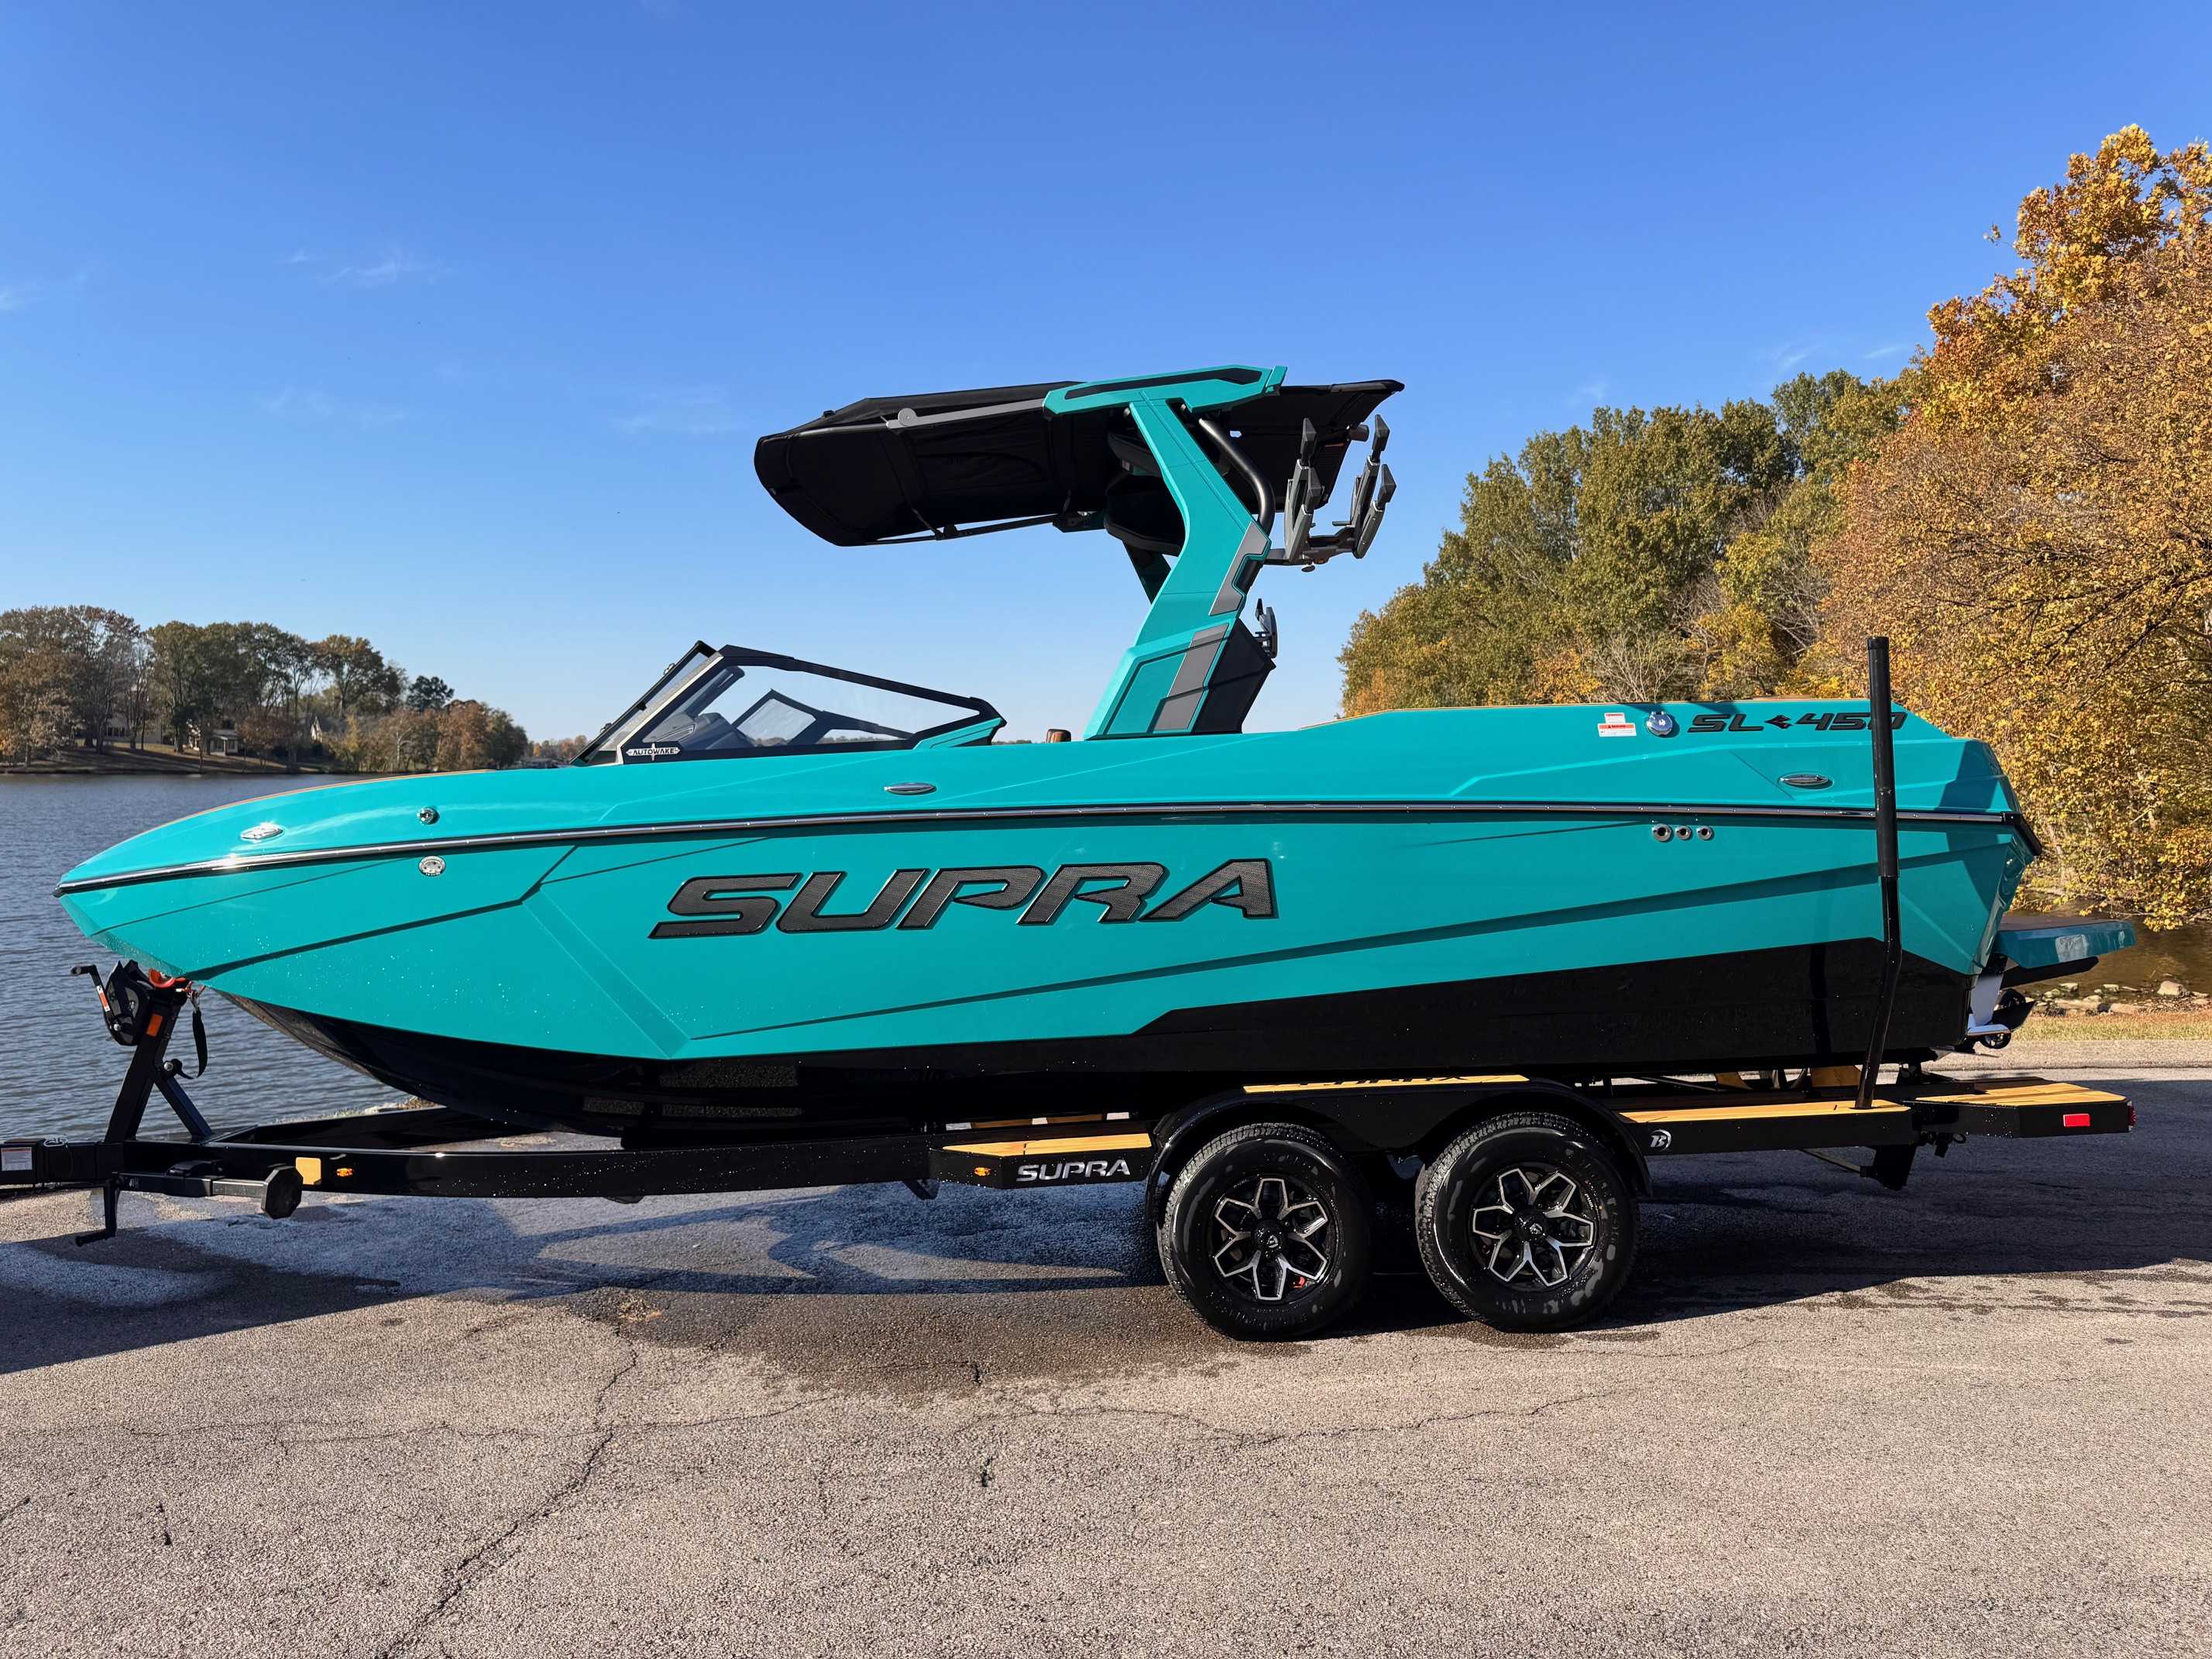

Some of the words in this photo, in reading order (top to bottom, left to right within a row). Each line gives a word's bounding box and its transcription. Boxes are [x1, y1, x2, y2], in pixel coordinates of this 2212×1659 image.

[1688, 713, 1764, 733] SL
[633, 747, 675, 756] AUTOWAKE
[647, 857, 1279, 939] SUPRA
[1016, 1159, 1131, 1182] SUPRA
